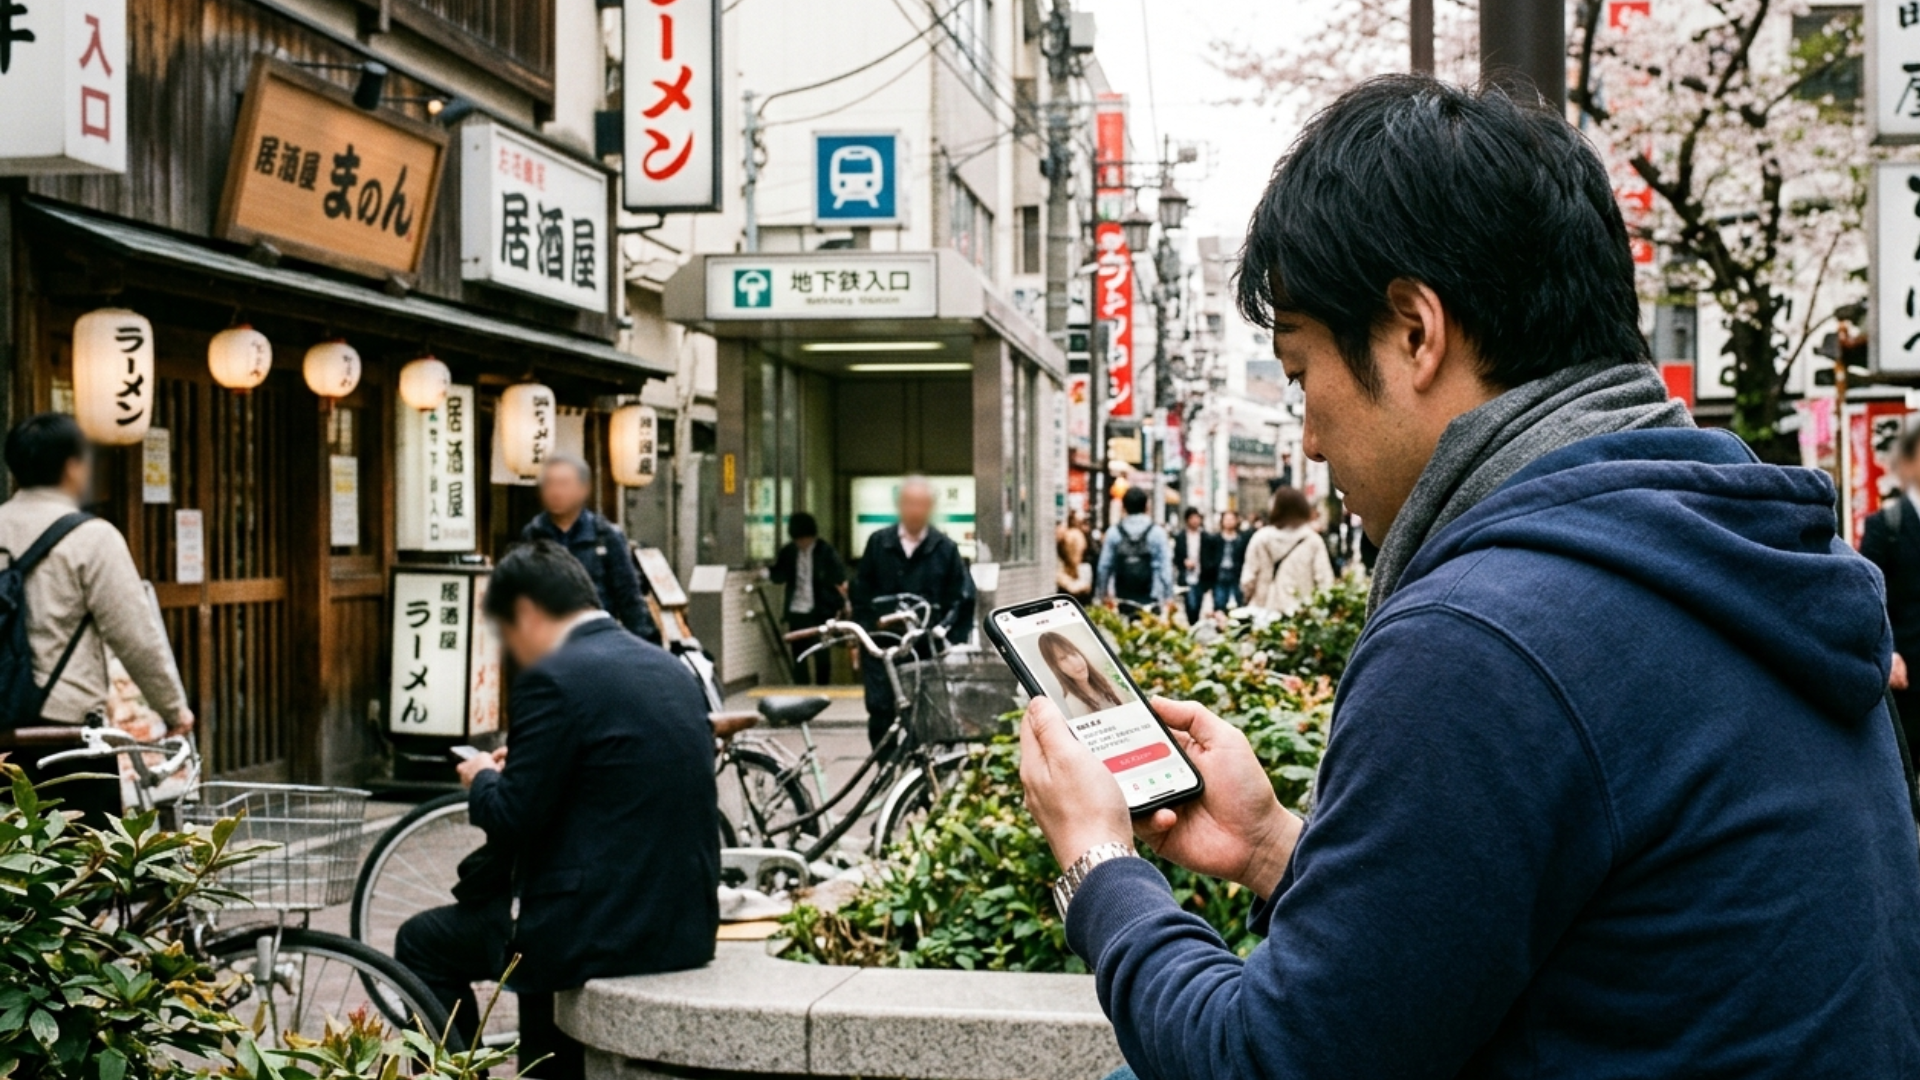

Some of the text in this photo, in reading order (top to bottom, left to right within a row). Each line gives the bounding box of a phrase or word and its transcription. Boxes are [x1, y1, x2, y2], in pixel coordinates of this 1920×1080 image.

[79, 13, 113, 143] 入口
[642, 0, 694, 181] ーメン
[323, 143, 415, 238] まのん
[500, 191, 597, 291] 居酒屋
[790, 269, 910, 293] 地下鉄入口
[114, 326, 145, 427] ラーメン
[402, 600, 431, 724] ラーメん
[440, 581, 459, 650] 居酒屋
